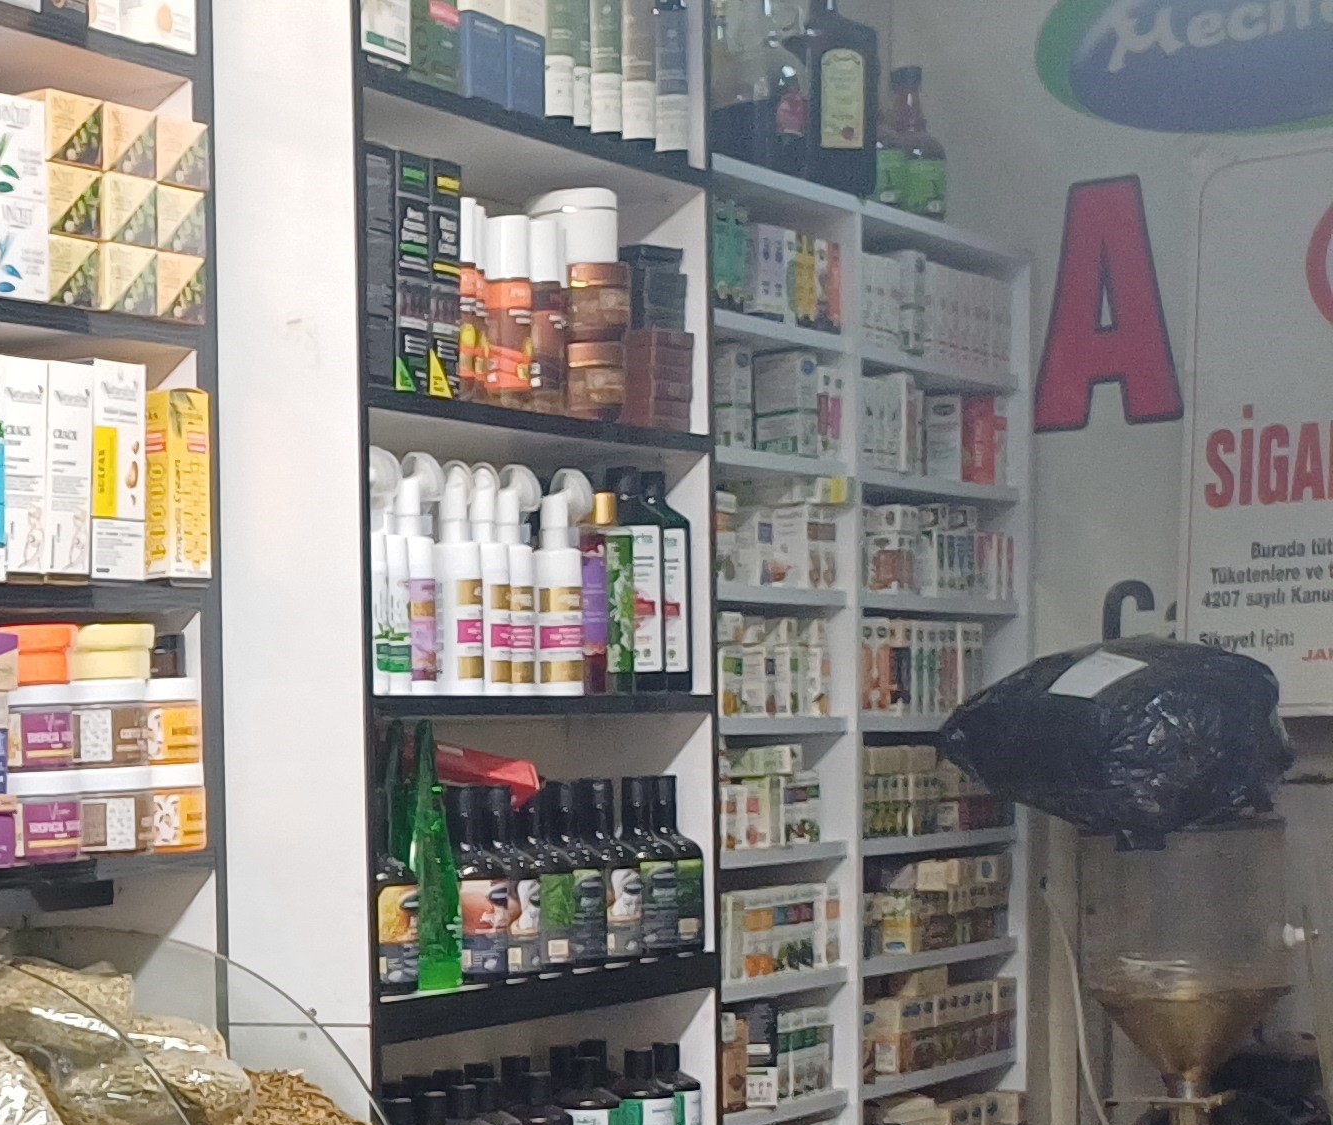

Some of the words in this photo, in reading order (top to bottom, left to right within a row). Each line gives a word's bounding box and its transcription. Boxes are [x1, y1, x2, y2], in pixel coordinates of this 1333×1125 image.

[1033, 173, 1184, 434] A
[1204, 403, 1333, 510] SİGA
[1202, 589, 1240, 609] 4207
[1305, 566, 1324, 580] ve
